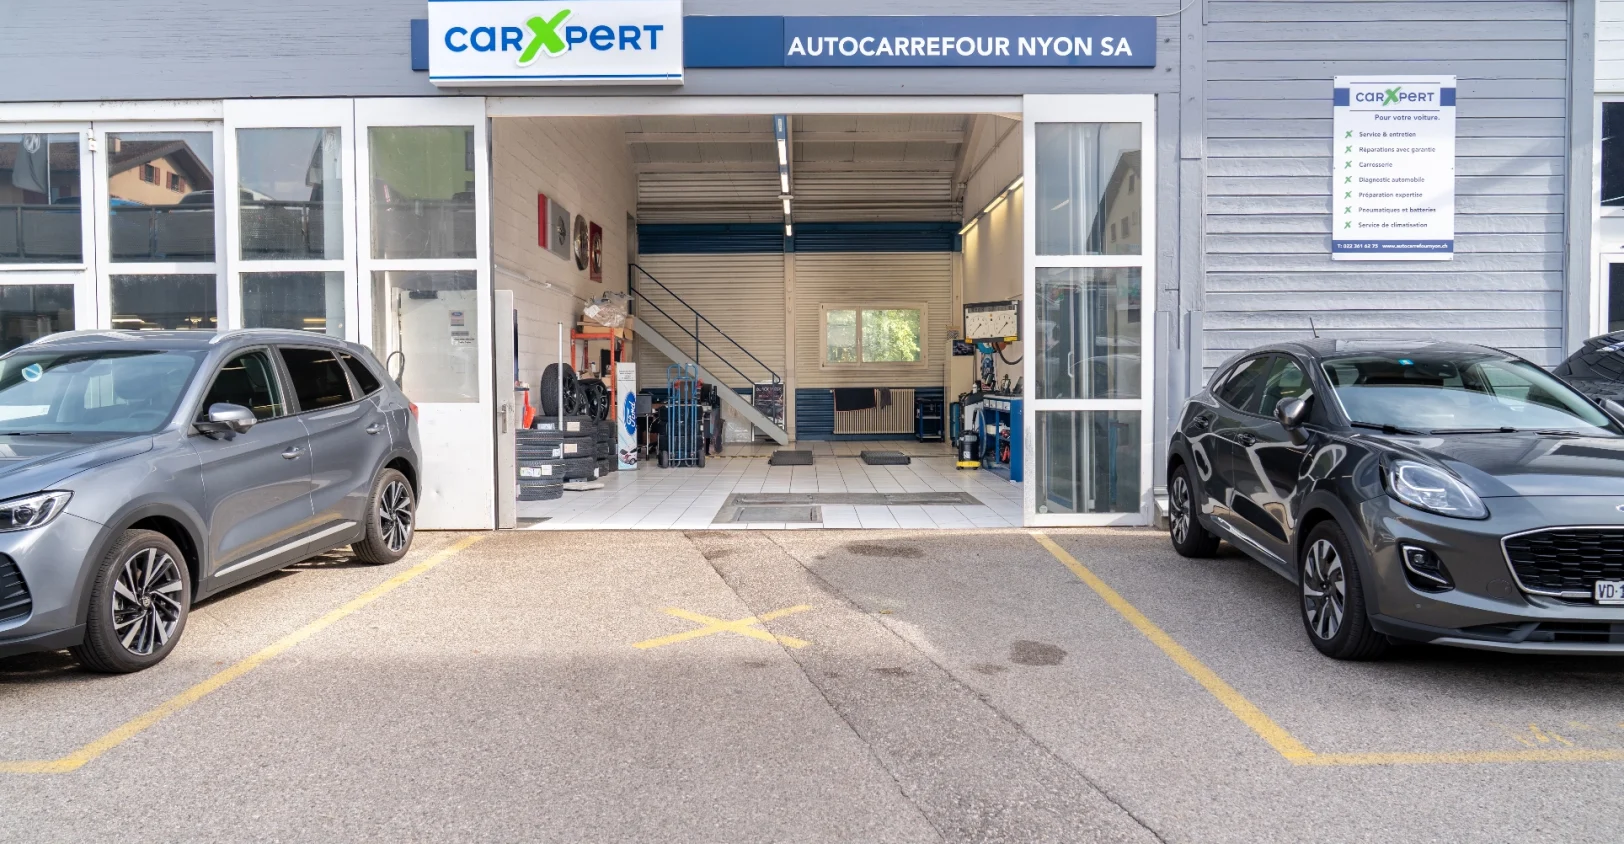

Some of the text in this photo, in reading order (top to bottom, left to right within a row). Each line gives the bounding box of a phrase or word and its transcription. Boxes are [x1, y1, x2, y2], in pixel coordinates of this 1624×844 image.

[787, 36, 1133, 57] AUTOCARREFOUR NYON SA
[1358, 146, 1395, 154] Réparations
[1358, 176, 1391, 184] Diagnostic
[1358, 191, 1423, 199] Préparation expertise
[1358, 206, 1401, 214] Pneumatiques
